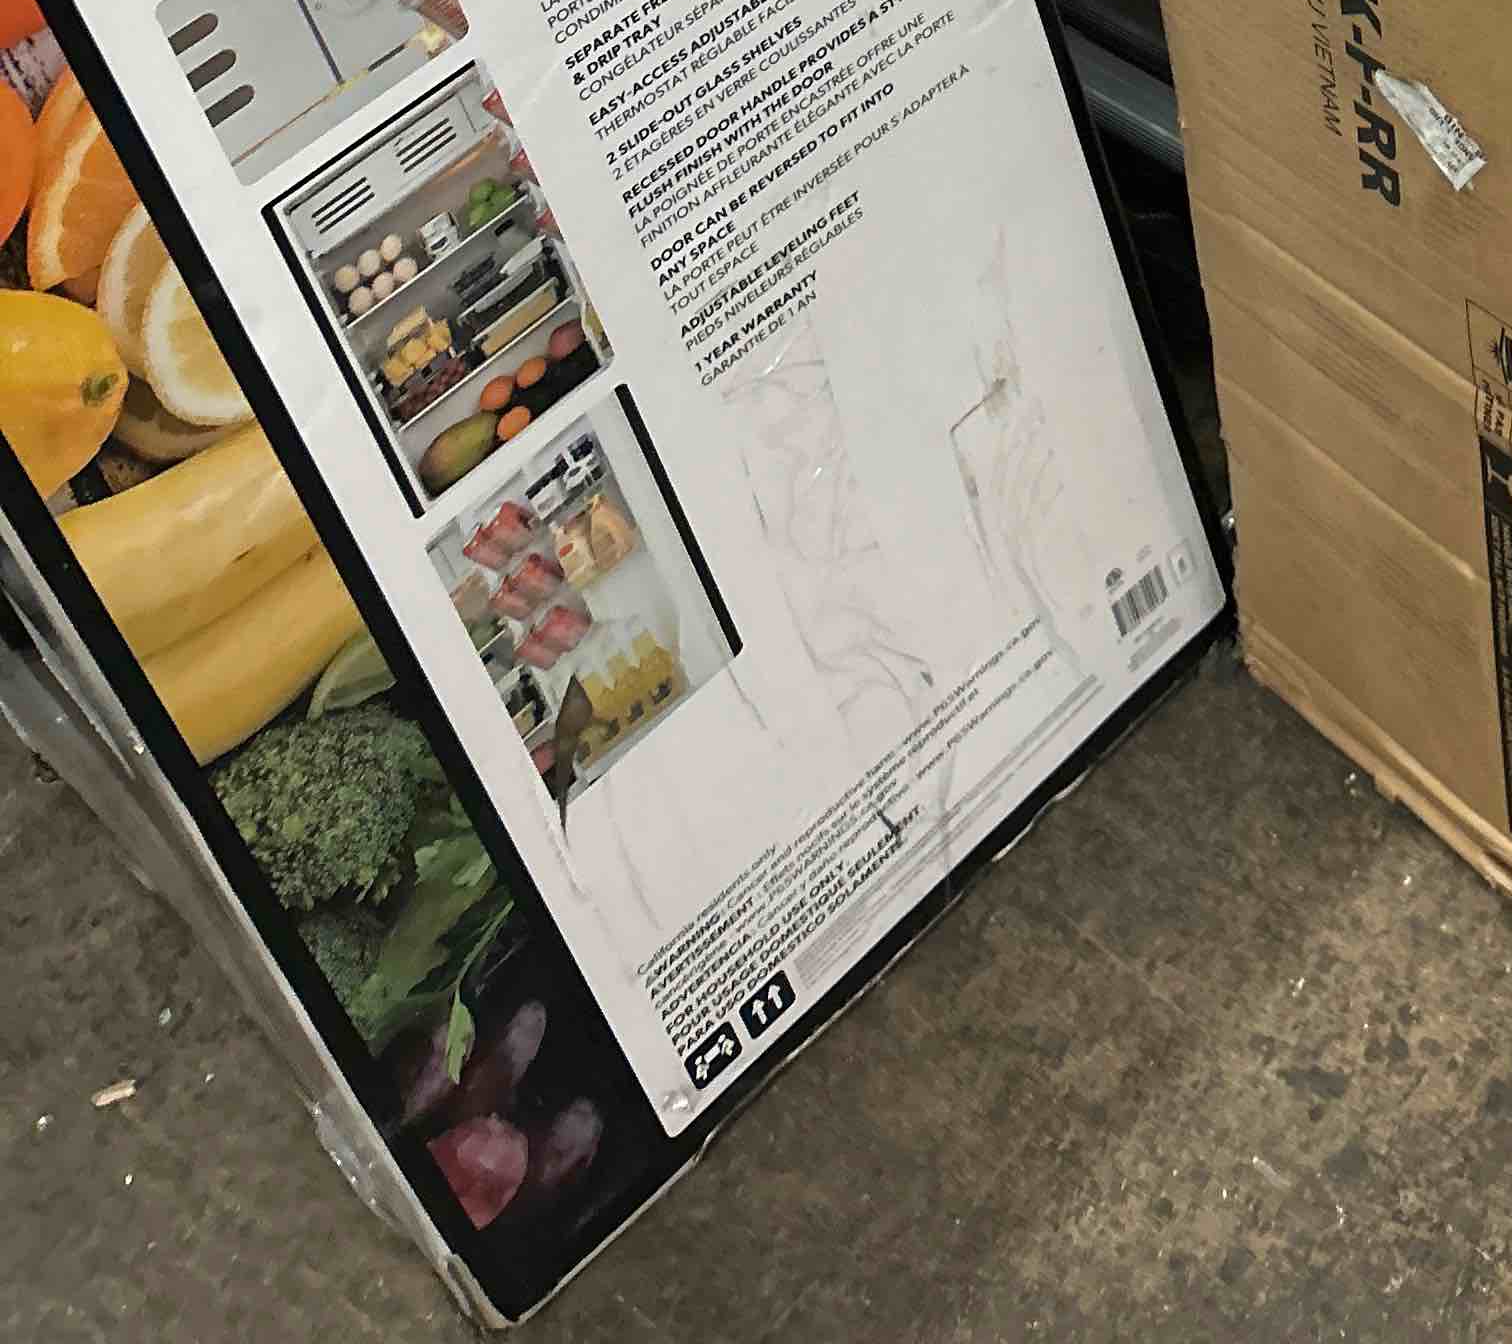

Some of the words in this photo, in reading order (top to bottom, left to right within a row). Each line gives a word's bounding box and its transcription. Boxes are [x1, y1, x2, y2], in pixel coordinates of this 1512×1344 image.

[564, 9, 641, 70] SEPARATE
[572, 71, 586, 86] &
[586, 44, 621, 76] DRIP
[622, 14, 661, 49] TRAY
[588, 47, 689, 126] EASY-ACCESS
[606, 151, 618, 166] 2
[618, 93, 692, 156] SLIDE-OUT
[695, 60, 741, 99] GLASS
[741, 16, 802, 66] SHELVES
[1311, 20, 1344, 138] VIETNAM
[622, 145, 694, 204] RECESSED
[695, 111, 740, 149] DOOR
[740, 67, 798, 116] HANDLE
[798, 17, 867, 73] PROVIDES
[869, 10, 880, 25] A
[628, 178, 674, 219] FLUSH
[674, 142, 723, 183] FINISH
[723, 113, 762, 146] WITH
[761, 91, 791, 118] THE
[791, 61, 834, 98] DOOR
[650, 231, 695, 272] DOOR
[695, 206, 728, 235] CAN
[728, 191, 748, 213] BE
[748, 140, 818, 198] REVERSED
[817, 124, 838, 143] TO
[839, 106, 858, 129] FIT
[860, 82, 894, 113] INTO
[659, 255, 687, 288] ANY
[689, 220, 736, 262] SPACE
[681, 264, 763, 339] ADJUSTABLE
[763, 216, 828, 272] LEVELING
[828, 190, 859, 221] FEET
[703, 332, 741, 364] YEAR
[740, 269, 817, 335] WARRANTY
